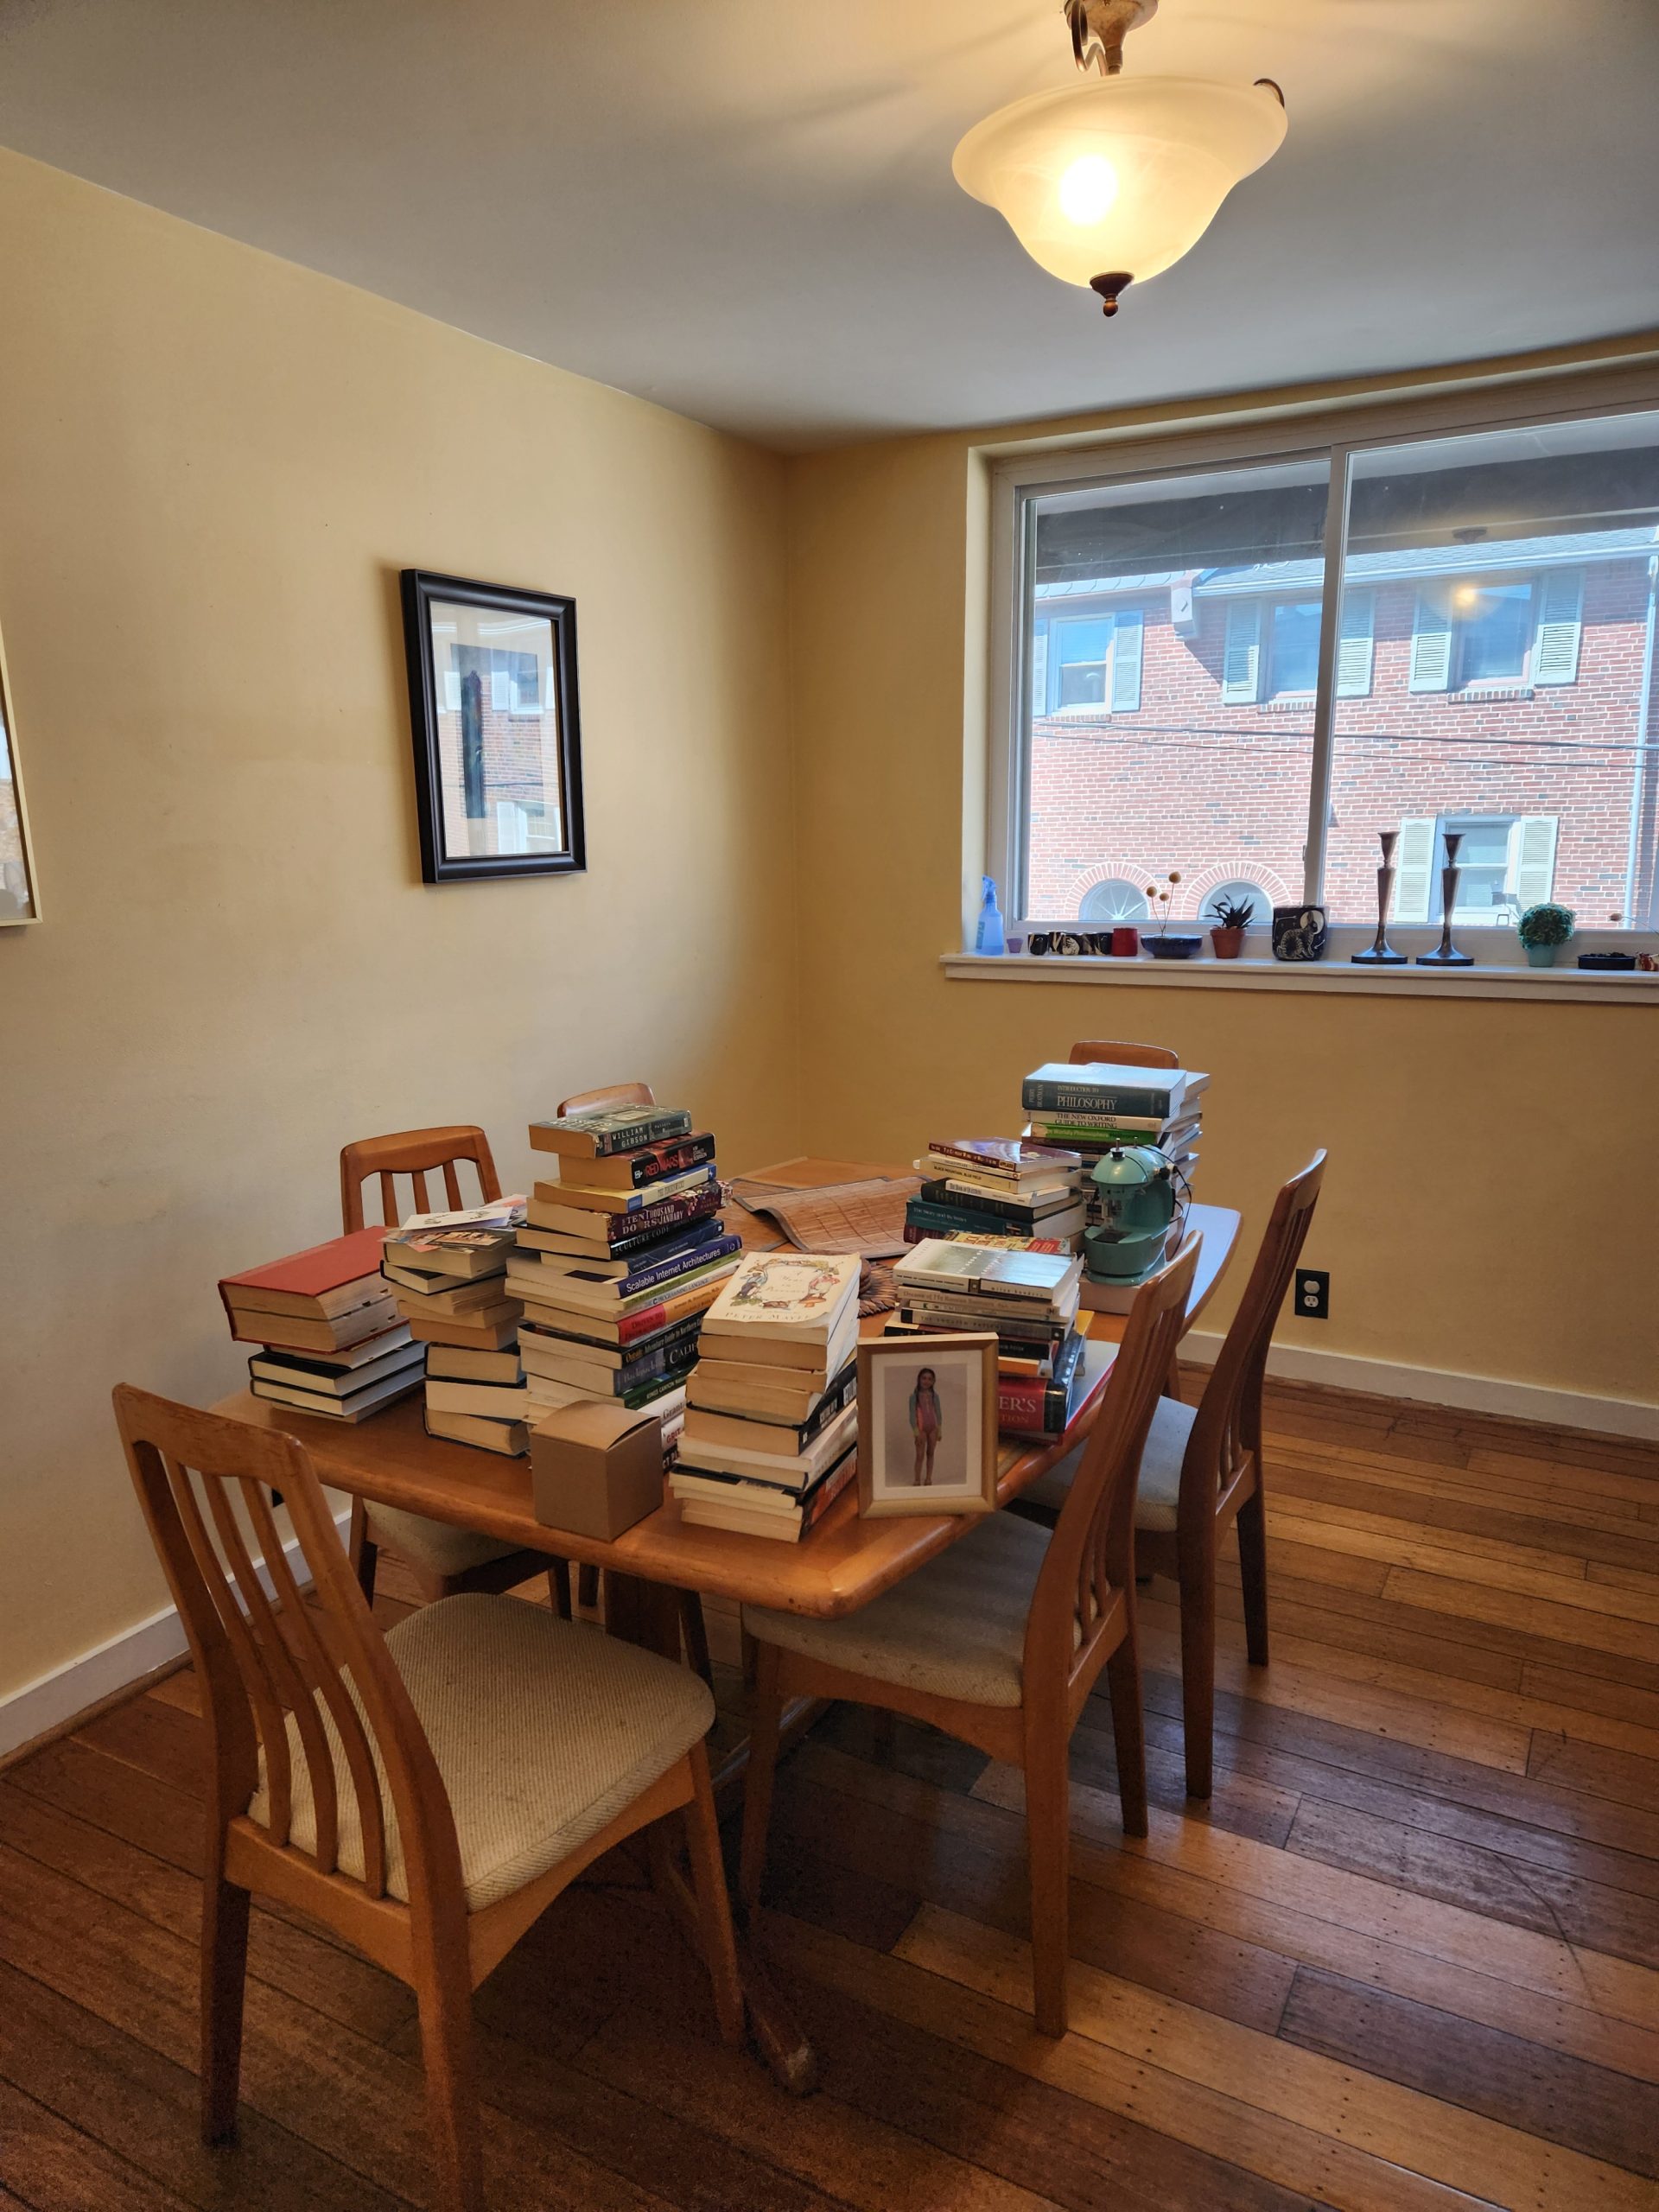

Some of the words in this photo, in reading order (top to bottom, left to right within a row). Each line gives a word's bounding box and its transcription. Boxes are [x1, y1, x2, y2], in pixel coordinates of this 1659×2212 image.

[1057, 1095, 1117, 1110] PHILOSOPHY
[612, 1127, 644, 1141] WILLIAM
[621, 1135, 648, 1148] GIBSON
[645, 1162, 659, 1176] RED
[658, 1154, 678, 1173] MARS
[626, 1211, 645, 1225] TEN
[645, 1205, 675, 1220] THOUSAND
[658, 1210, 683, 1225] JANUARY
[619, 1232, 650, 1251] CULTURE
[626, 1273, 655, 1293] Scalable
[656, 1265, 682, 1281] Internet
[682, 1248, 721, 1269] Architectures
[670, 1343, 696, 1364] CALIF
[1000, 1395, 1037, 1413] ER'S
[1001, 1414, 1029, 1423] TION
